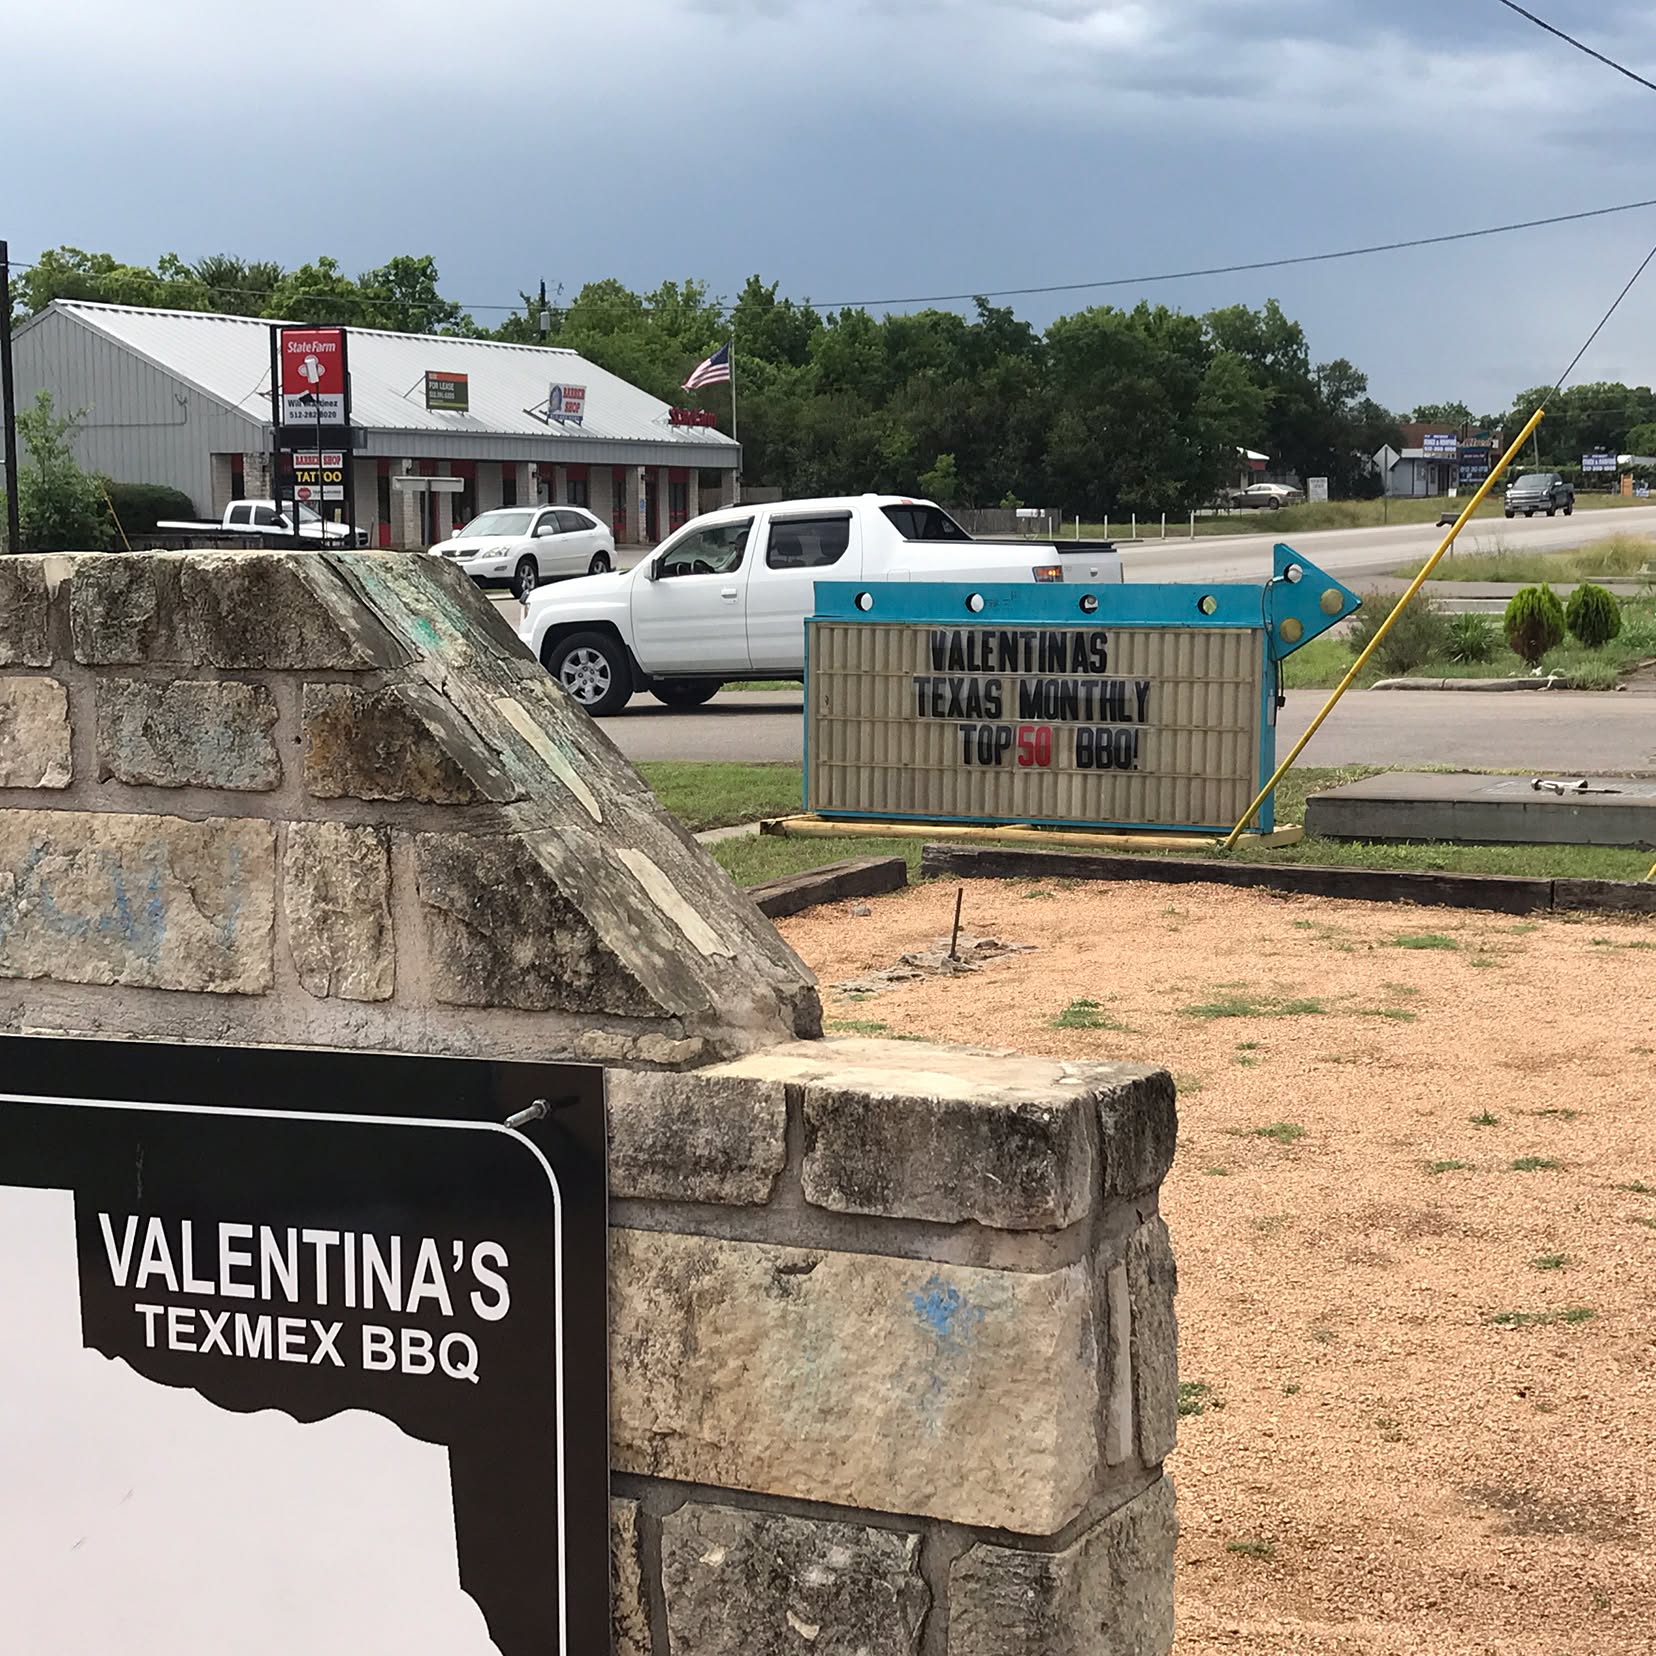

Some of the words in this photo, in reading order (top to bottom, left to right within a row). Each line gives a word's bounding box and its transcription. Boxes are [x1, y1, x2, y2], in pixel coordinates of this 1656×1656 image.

[931, 630, 1108, 673] VALENTINAS
[913, 677, 1002, 719] TEXAS
[1018, 679, 1150, 723] MONTHLY
[959, 724, 1012, 765] TOP
[1017, 725, 1051, 767] 50
[98, 1212, 511, 1321] VALENTINA'S
[134, 1303, 345, 1367] TEXMEX
[362, 1324, 480, 1385] BBQ
